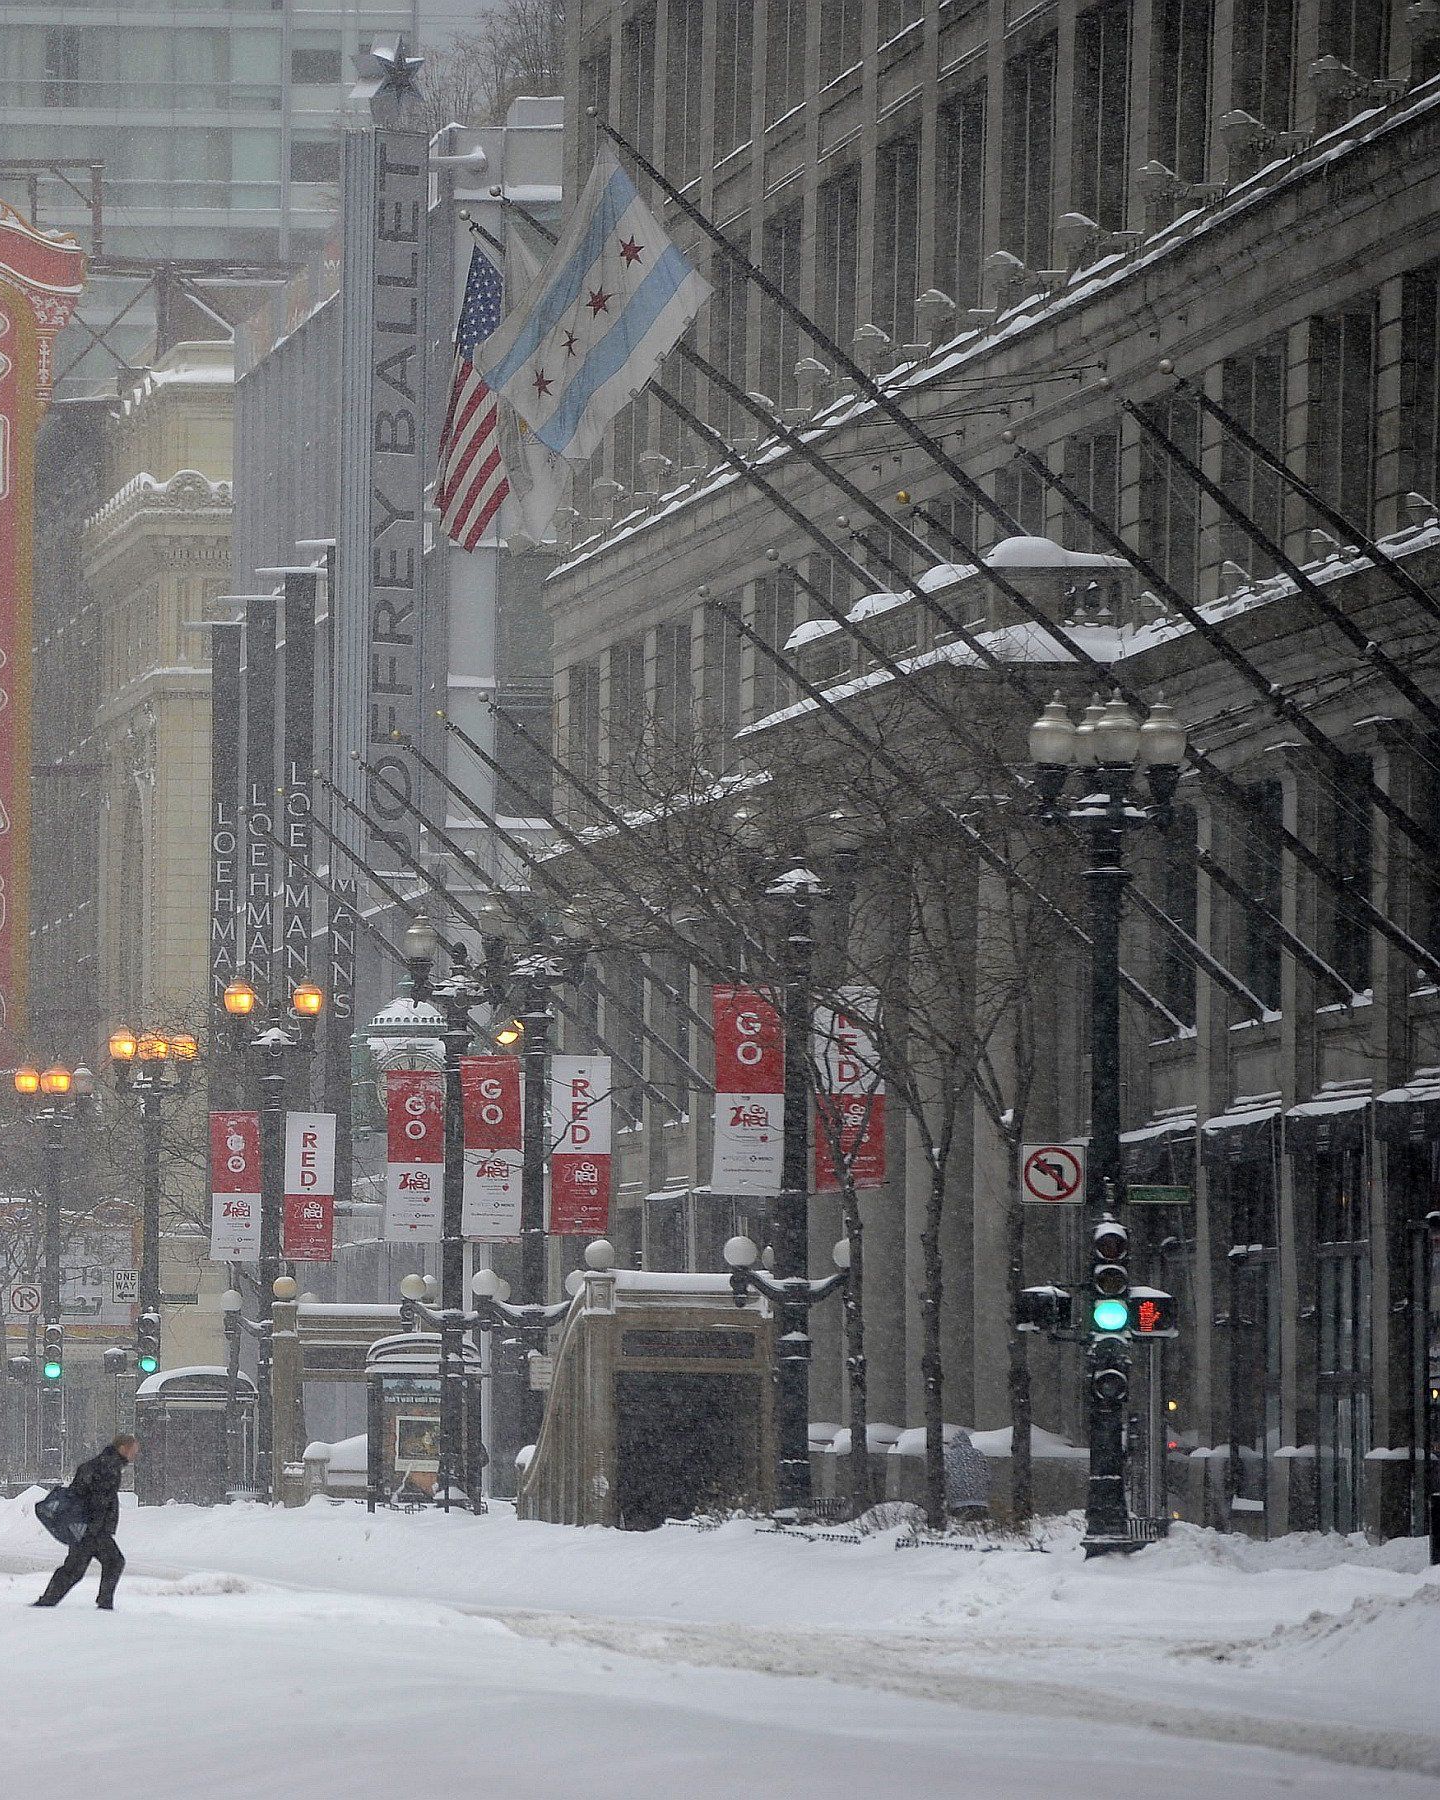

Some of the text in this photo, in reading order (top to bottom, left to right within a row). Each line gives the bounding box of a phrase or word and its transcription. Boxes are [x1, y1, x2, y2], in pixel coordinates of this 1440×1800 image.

[370, 143, 420, 868] JOFFREY BALLET
[736, 1012, 763, 1065] GO
[405, 1096, 427, 1140] GO
[480, 1079, 504, 1125] GO
[571, 1079, 591, 1144] RED
[300, 1132, 318, 1187] RED
[115, 1281, 137, 1291] WAY
[116, 1272, 136, 1282] ONE
